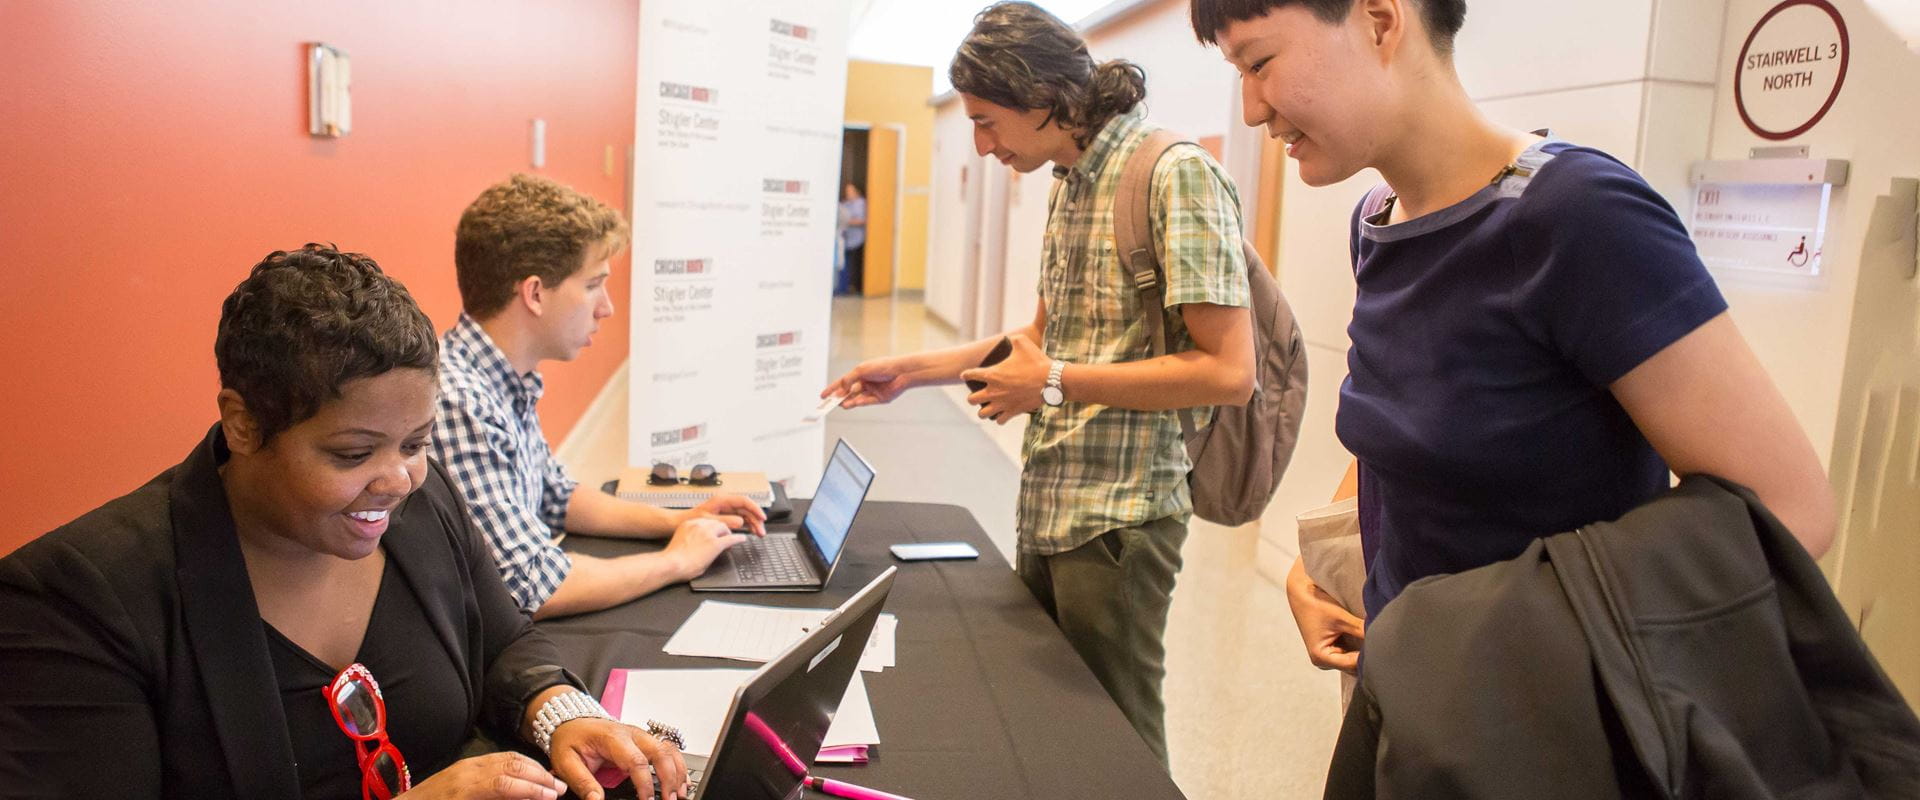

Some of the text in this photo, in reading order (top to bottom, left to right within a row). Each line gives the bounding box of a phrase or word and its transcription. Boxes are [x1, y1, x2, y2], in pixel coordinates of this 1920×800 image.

[1746, 43, 1838, 70] STAIRWELL 3
[1763, 72, 1813, 91] NORTH
[654, 286, 685, 303] Stigler
